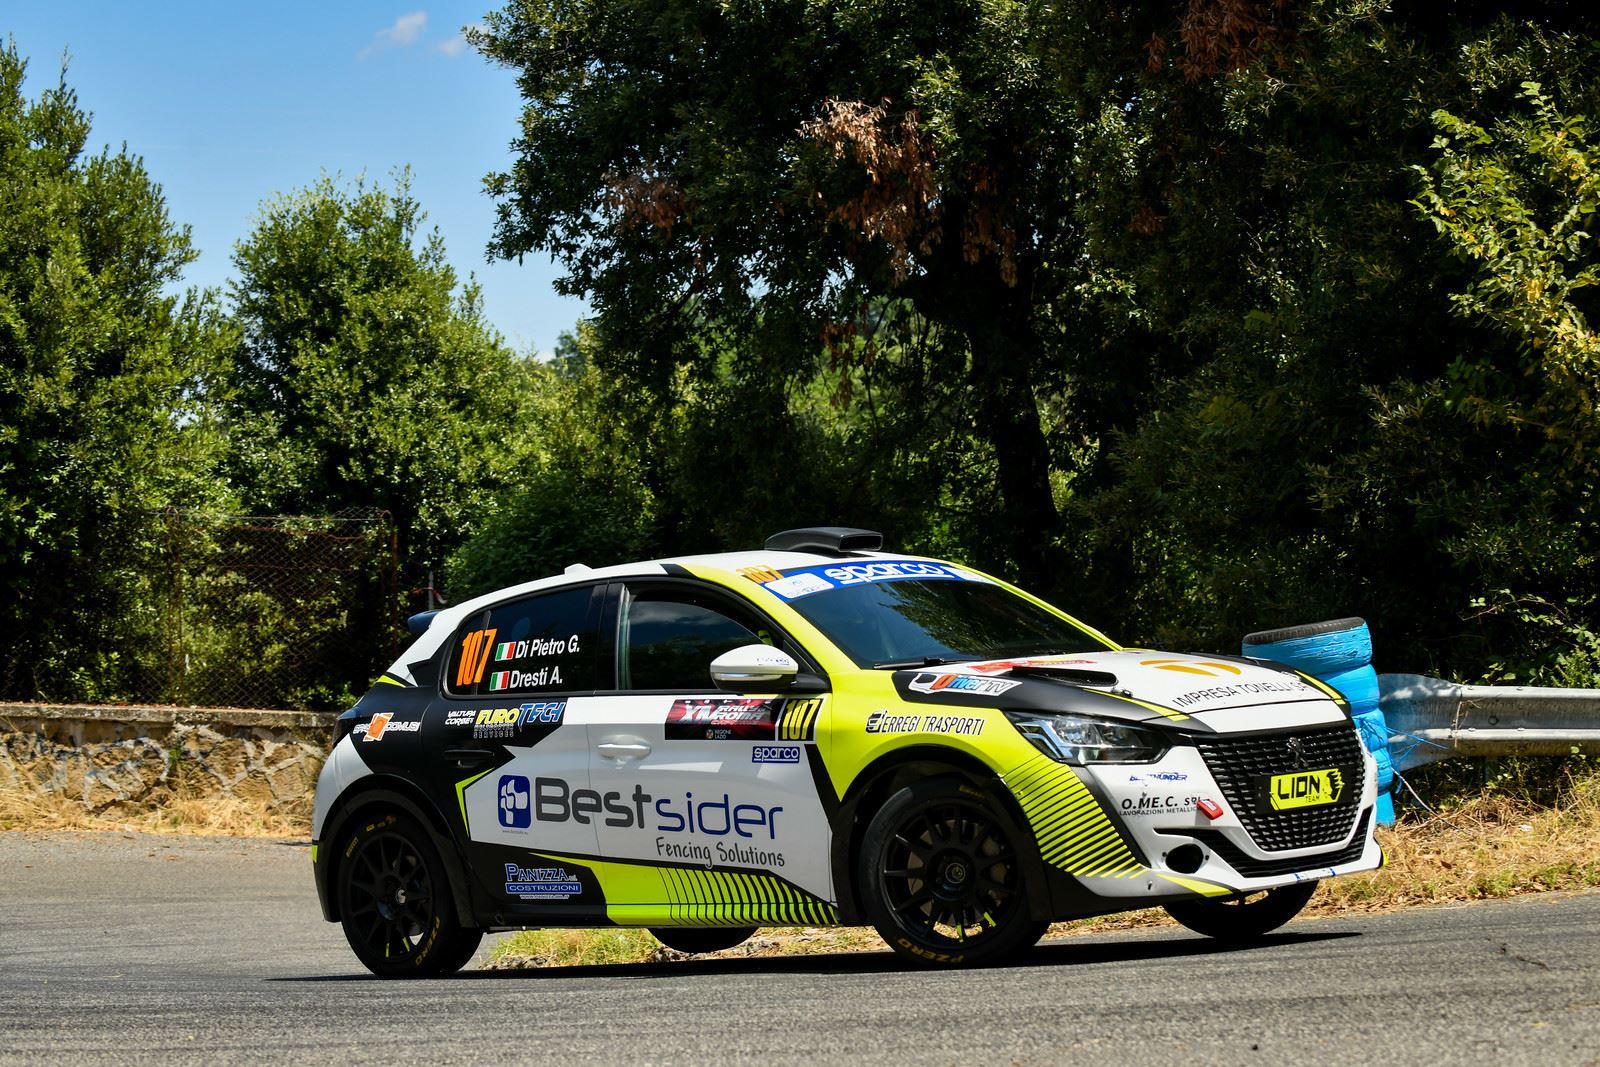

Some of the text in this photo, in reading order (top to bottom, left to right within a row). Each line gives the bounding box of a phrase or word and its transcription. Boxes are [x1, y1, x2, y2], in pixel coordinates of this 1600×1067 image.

[825, 563, 946, 584] sparco
[456, 628, 498, 687] 107
[515, 634, 580, 659] Di Pietro G.
[510, 665, 563, 689] Dresti A.
[1172, 686, 1239, 707] IMPRESA
[781, 699, 821, 740] 107
[881, 716, 985, 736] ERREGI TRASPORTI
[754, 747, 799, 762] sparco
[1278, 775, 1321, 800] LION
[535, 777, 783, 839] Bestsider
[1305, 795, 1320, 803] TEAM
[1119, 808, 1165, 816] LAVORAZIONI
[656, 837, 785, 869] Fencing Solutions
[508, 884, 580, 892] COSTRUZIONI
